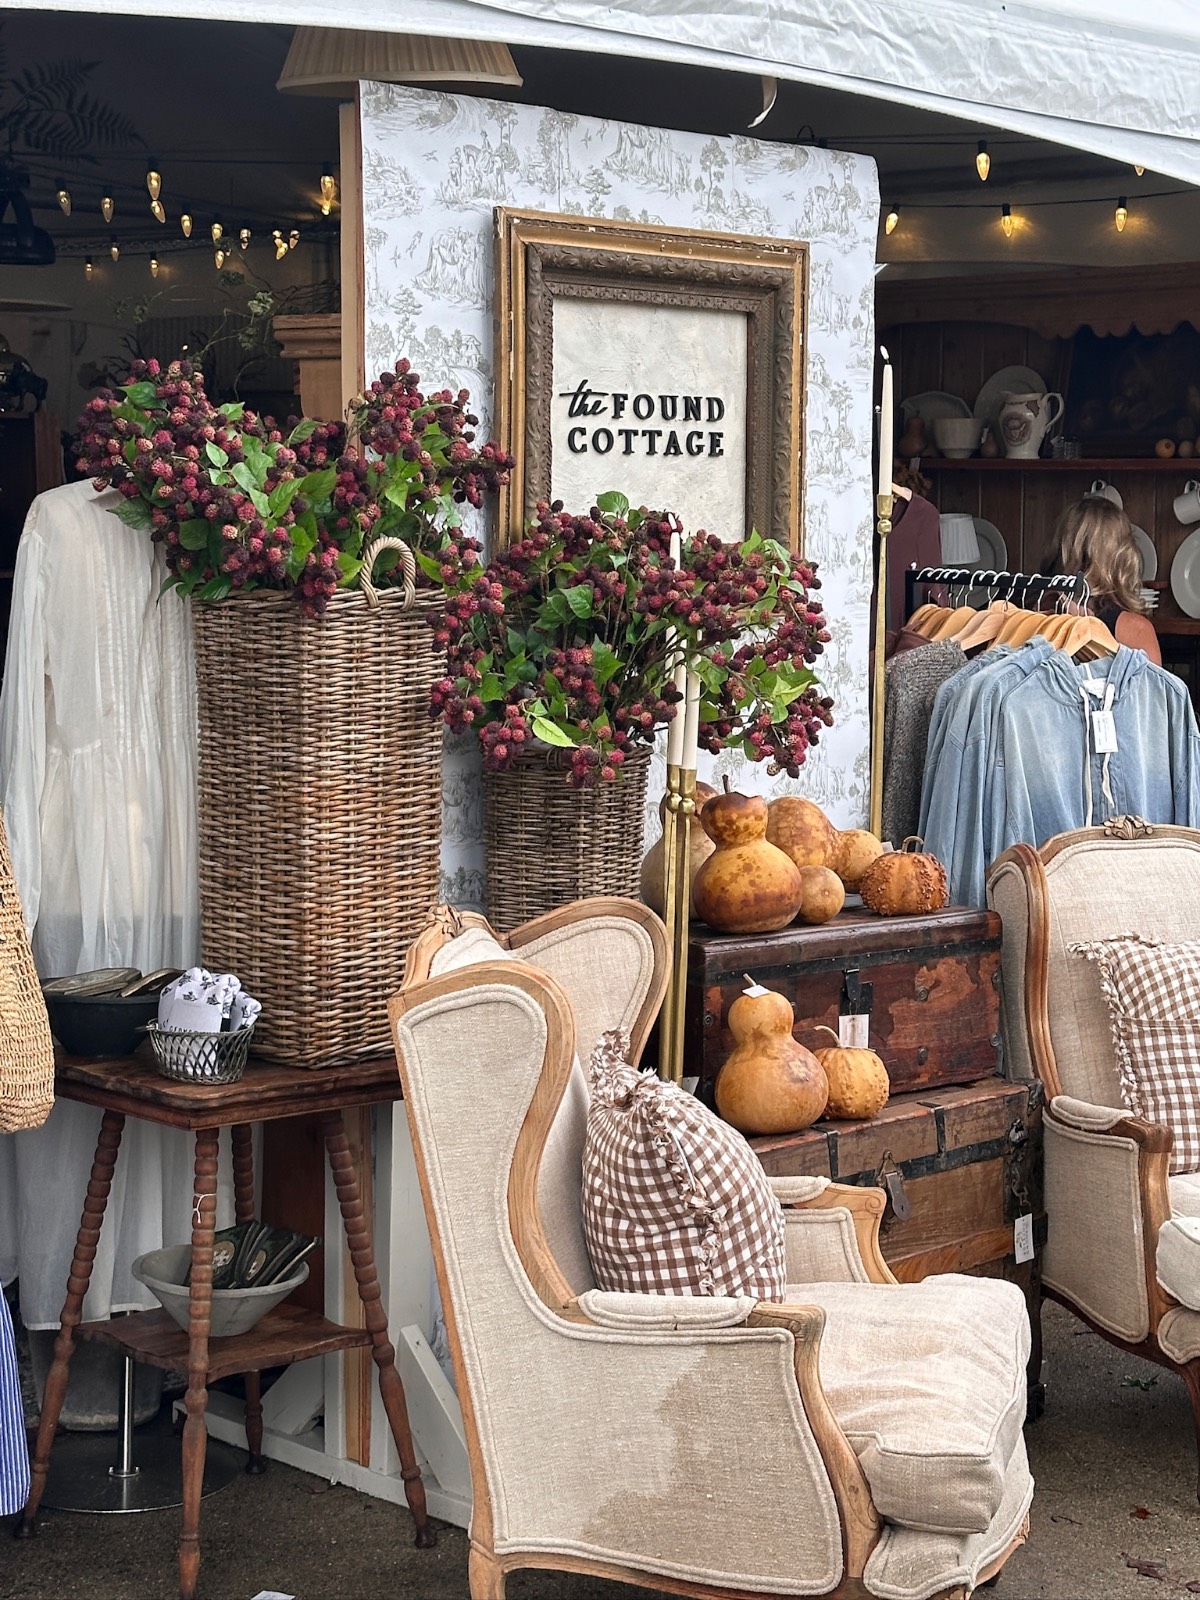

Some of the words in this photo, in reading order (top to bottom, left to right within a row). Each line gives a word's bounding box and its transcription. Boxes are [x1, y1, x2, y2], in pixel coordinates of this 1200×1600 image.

[559, 379, 610, 418] the
[611, 393, 725, 422] FOUND
[567, 426, 724, 458] COTTAGE
